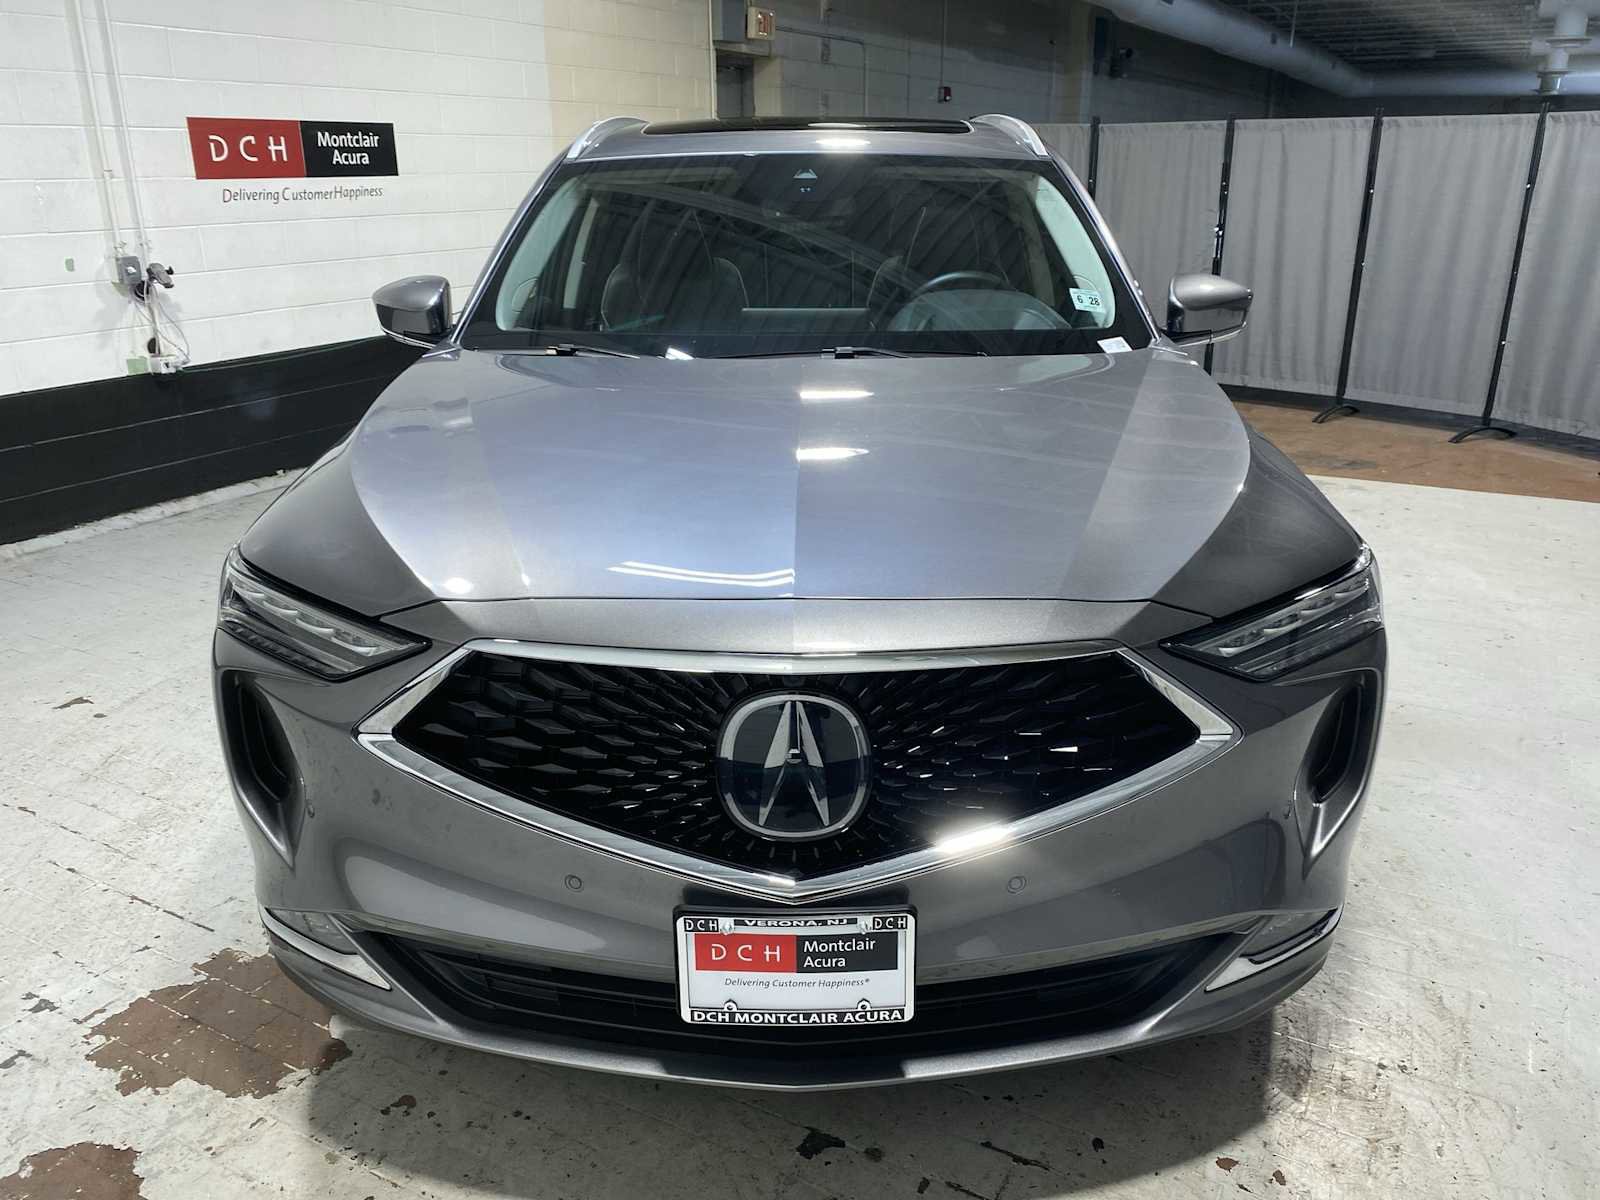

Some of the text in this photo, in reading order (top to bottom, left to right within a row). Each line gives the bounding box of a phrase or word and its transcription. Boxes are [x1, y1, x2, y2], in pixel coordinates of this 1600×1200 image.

[317, 131, 380, 149] Montclair
[208, 135, 288, 162] DCH
[332, 150, 370, 165] Acura
[222, 188, 280, 204] Delivering
[1077, 295, 1100, 306] 6 28
[685, 919, 718, 931] DCH
[827, 918, 847, 926] NJ
[874, 917, 906, 929] DCH
[711, 943, 781, 962] DCH
[803, 938, 876, 953] Montclair
[803, 955, 846, 968] Acura
[724, 978, 770, 988] Delivering
[772, 979, 816, 988] Customer
[693, 1009, 902, 1024] DCH MONTCLAIR ACURA
